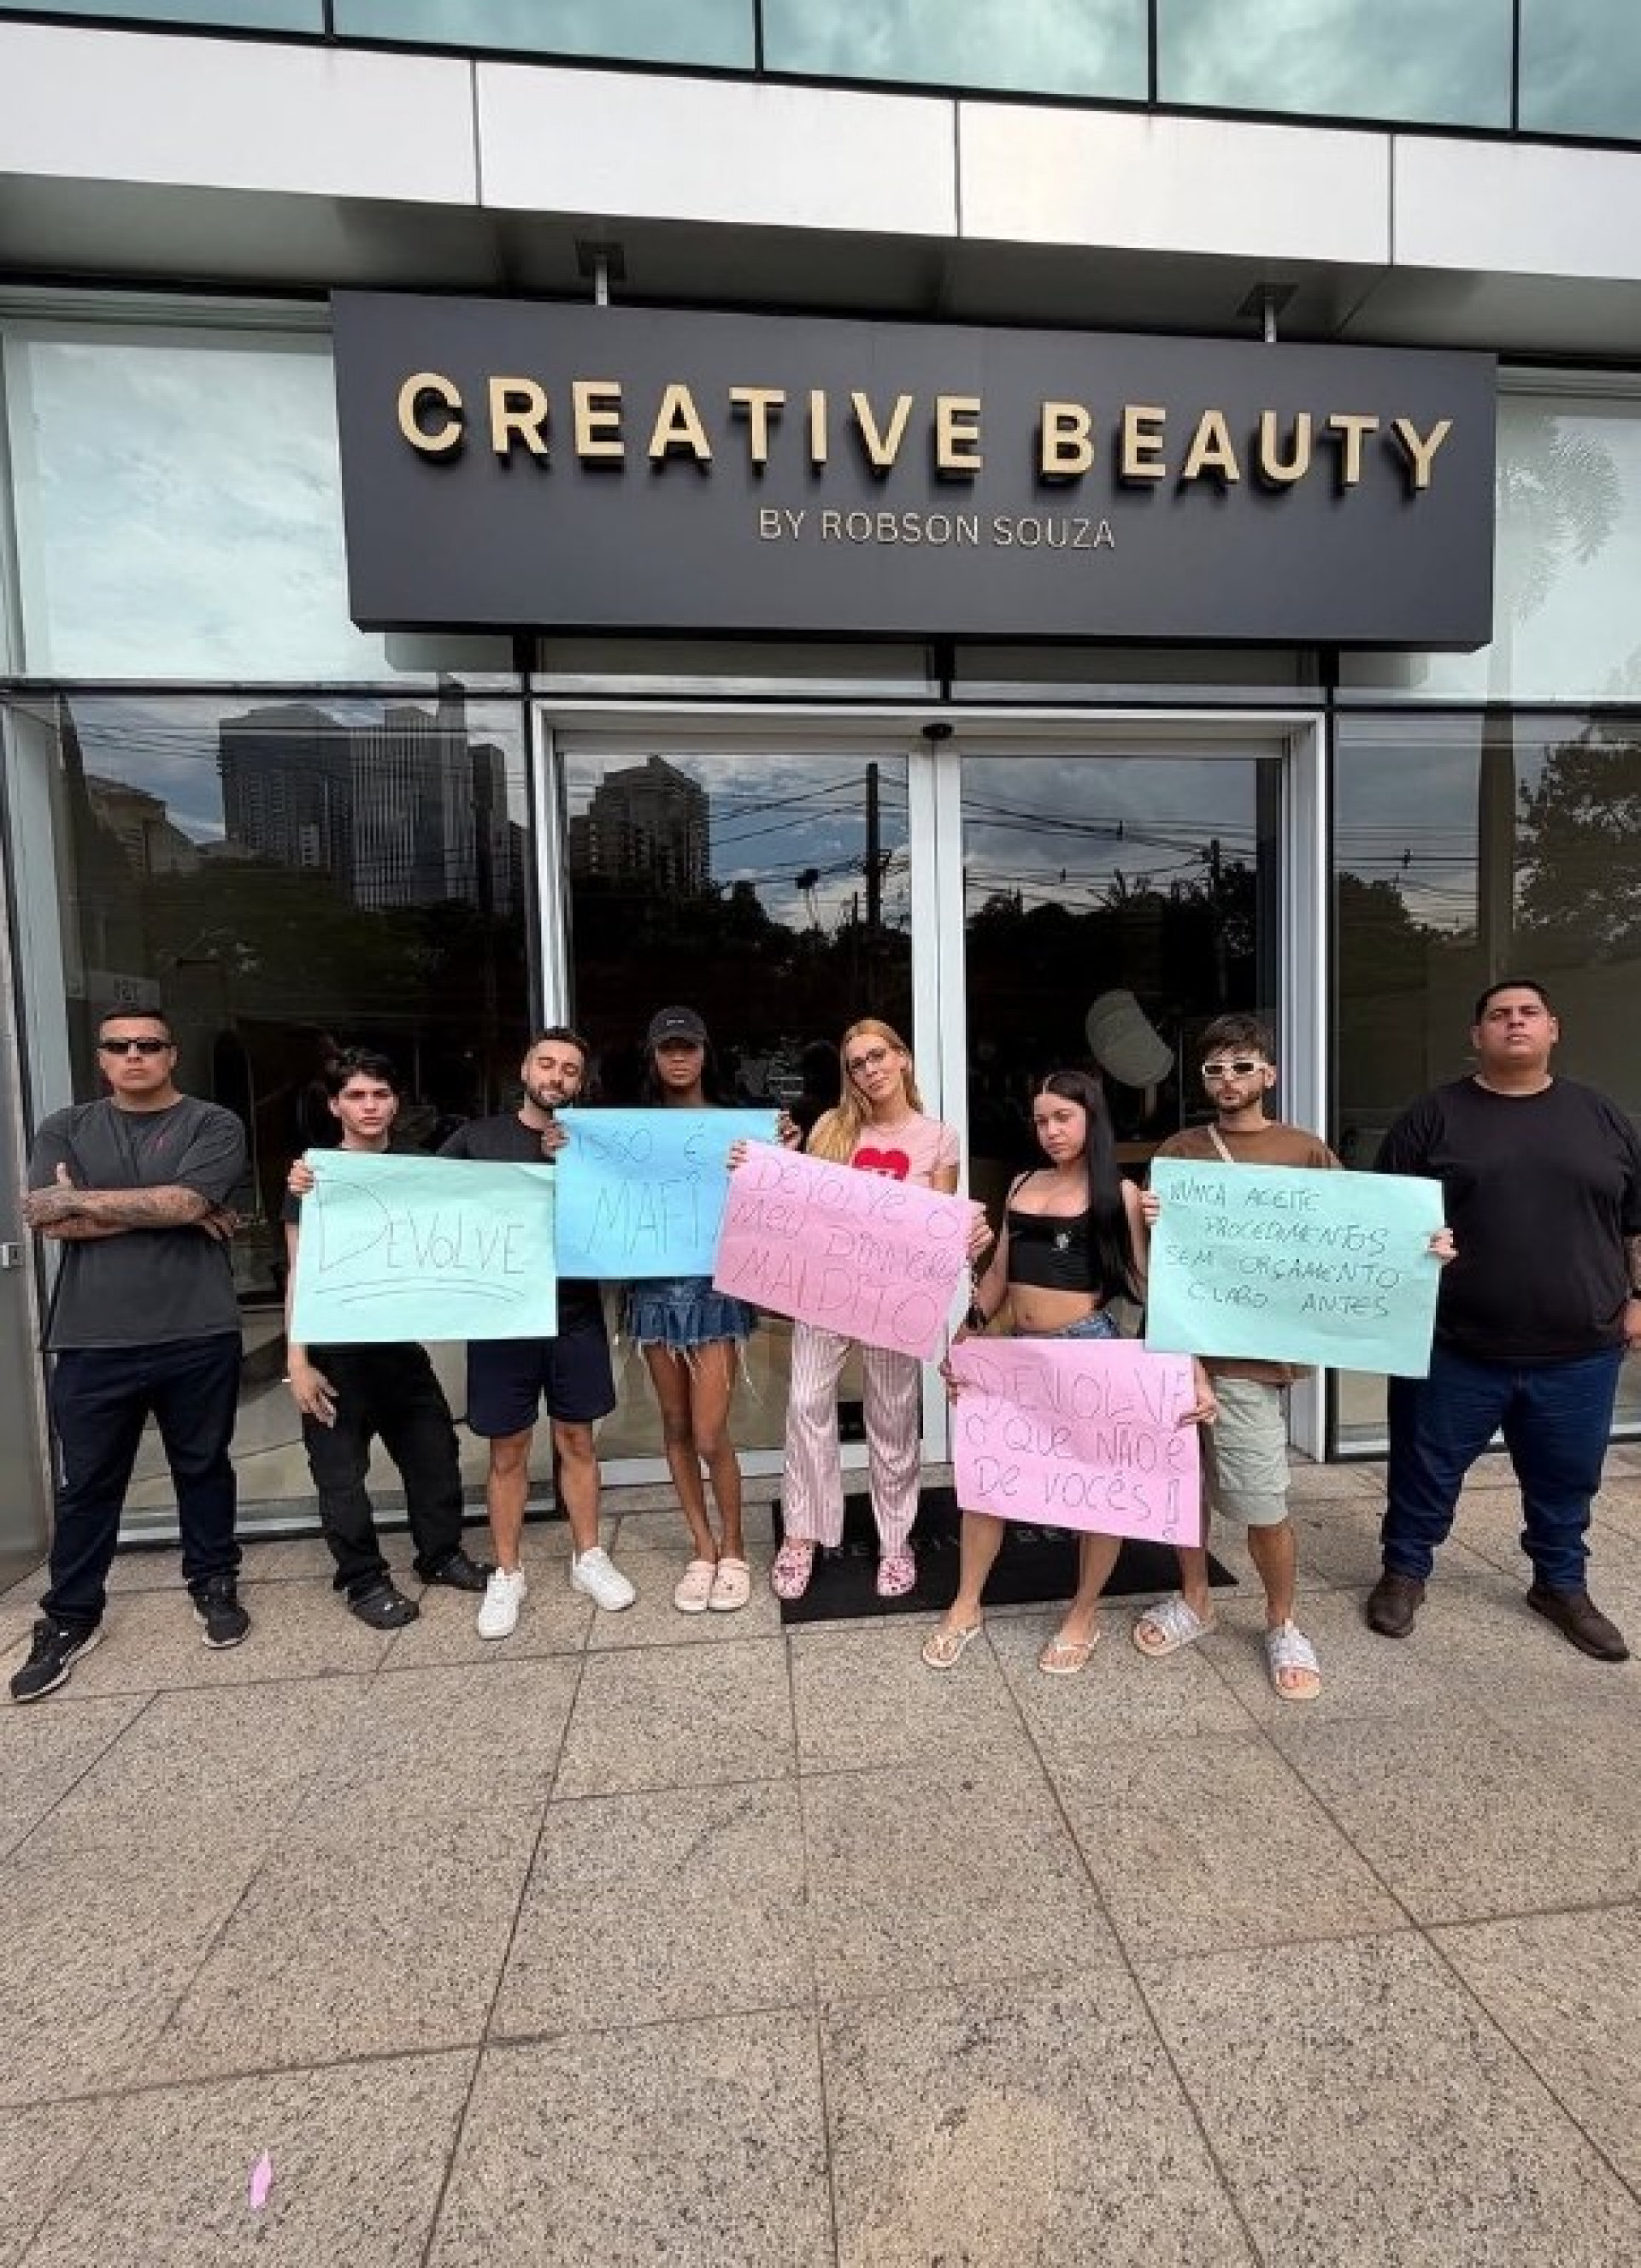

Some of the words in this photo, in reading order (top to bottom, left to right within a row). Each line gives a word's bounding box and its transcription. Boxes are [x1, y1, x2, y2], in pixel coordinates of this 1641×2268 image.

[397, 372, 981, 473] CREATIVE
[1040, 401, 1451, 489] BEAUTY
[759, 509, 807, 540] BY
[822, 510, 980, 547] ROBSON
[992, 515, 1115, 550] SOUZA
[1168, 1175, 1226, 1207] NUNCA
[1244, 1187, 1321, 1212] ACEITE
[316, 1179, 525, 1275] DEVOLVE
[1166, 1245, 1214, 1266] SEM
[1238, 1253, 1400, 1289] ORÇAMENTO
[1299, 1293, 1390, 1317] ANTES
